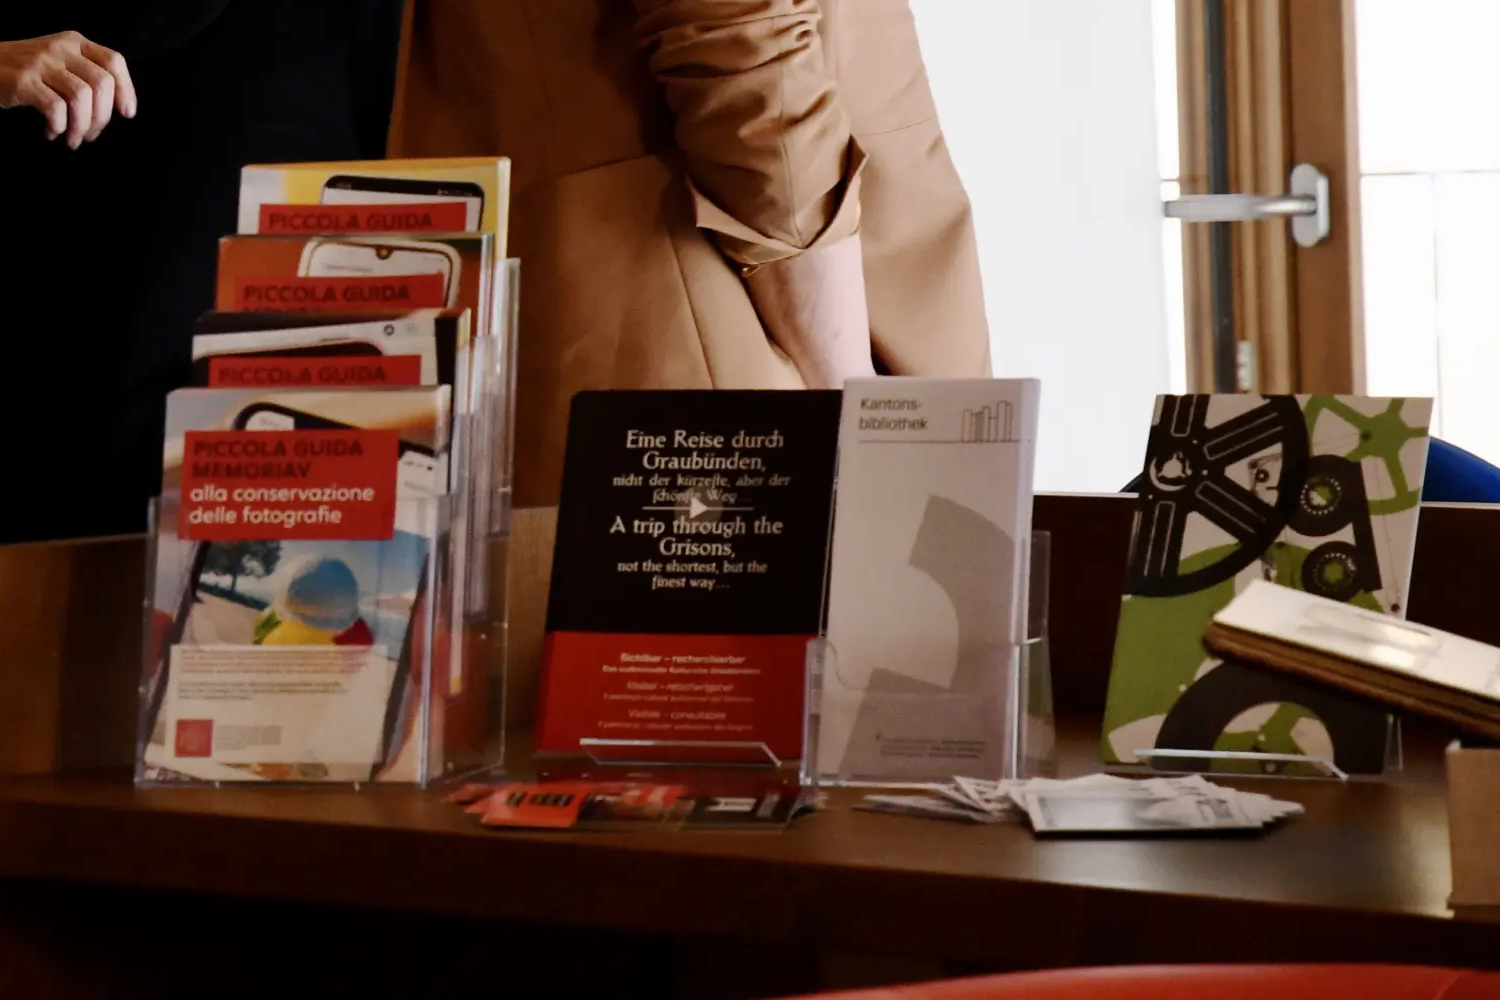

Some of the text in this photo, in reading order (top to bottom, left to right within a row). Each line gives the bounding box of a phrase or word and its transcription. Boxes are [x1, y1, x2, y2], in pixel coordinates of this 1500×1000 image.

[268, 212, 433, 230] PICCOLA GUIDA
[243, 284, 410, 302] PICCOLA GUIDA
[218, 366, 387, 384] PICCOLA GUIDA
[861, 398, 924, 410] Kantons-
[859, 416, 927, 430] bibliothek
[194, 438, 363, 456] PICCOLA GUIDA
[626, 430, 783, 448] Eine Reise durch
[191, 462, 312, 479] MEMORIAV
[642, 451, 766, 472] Graubünden,
[613, 473, 642, 486] nicht
[649, 473, 671, 486] der
[735, 474, 763, 486] aber
[768, 474, 791, 486] der
[190, 484, 375, 501] alla conservazione
[189, 505, 343, 529] delle fotografie
[610, 515, 783, 538] A trip through the
[659, 537, 736, 559] Grisons,
[617, 558, 768, 574] not the shortest, but the
[652, 574, 686, 590] finest
